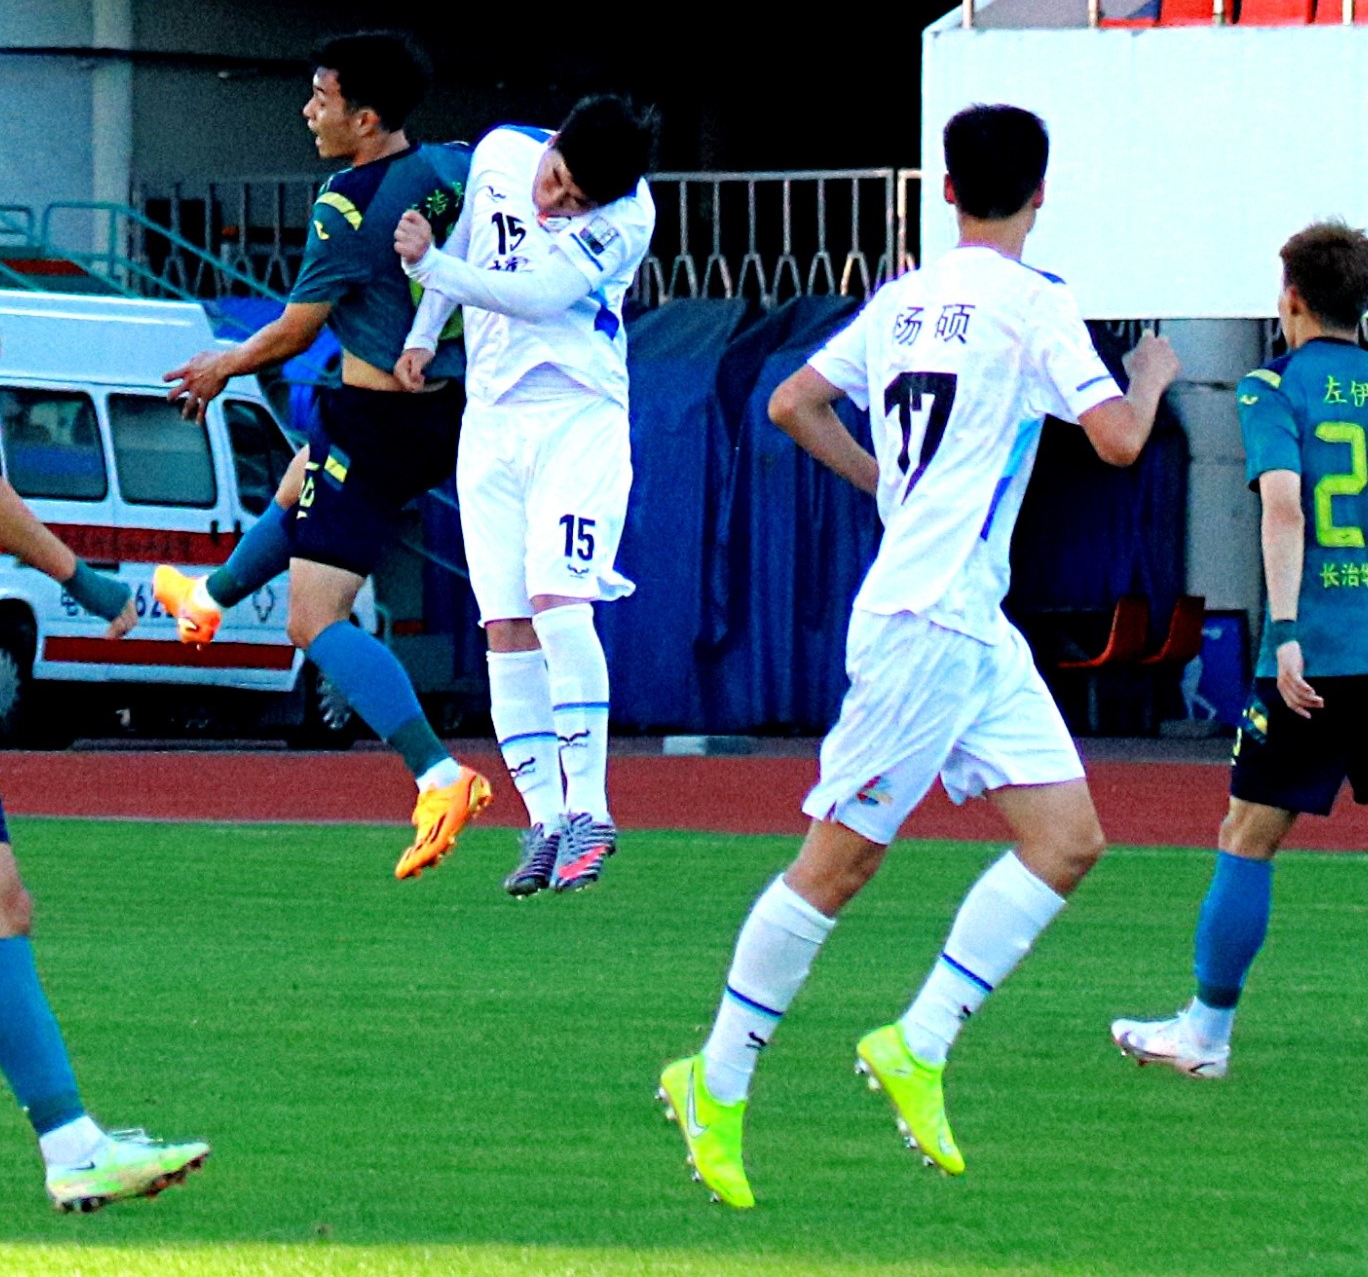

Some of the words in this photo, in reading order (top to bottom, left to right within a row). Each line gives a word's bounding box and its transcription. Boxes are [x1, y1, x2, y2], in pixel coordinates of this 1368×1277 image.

[491, 211, 527, 256] 15
[883, 370, 958, 506] 17
[558, 513, 596, 562] 15
